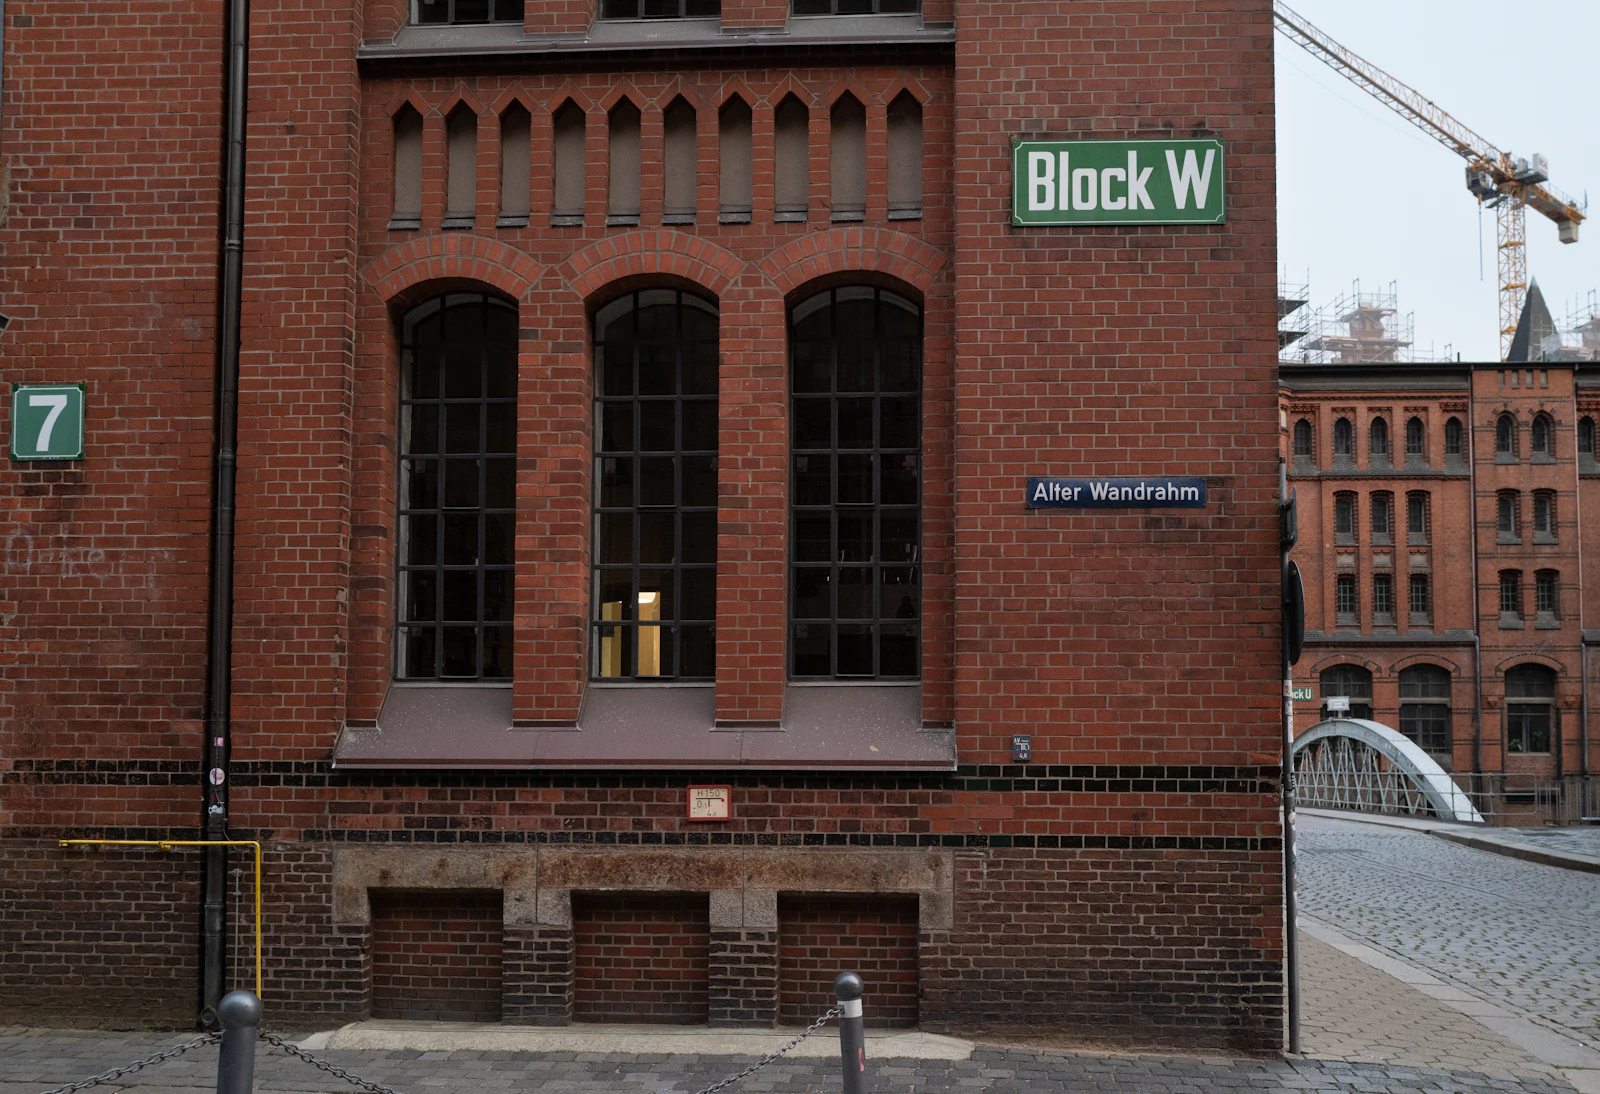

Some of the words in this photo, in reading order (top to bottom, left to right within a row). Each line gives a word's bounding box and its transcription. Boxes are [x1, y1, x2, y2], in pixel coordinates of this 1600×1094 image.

[1028, 150, 1155, 211] Block
[1164, 149, 1216, 209] W
[29, 394, 67, 452] 7
[1033, 482, 1081, 501] Alter
[1089, 482, 1199, 501] Wandrahm
[1305, 688, 1312, 699] U
